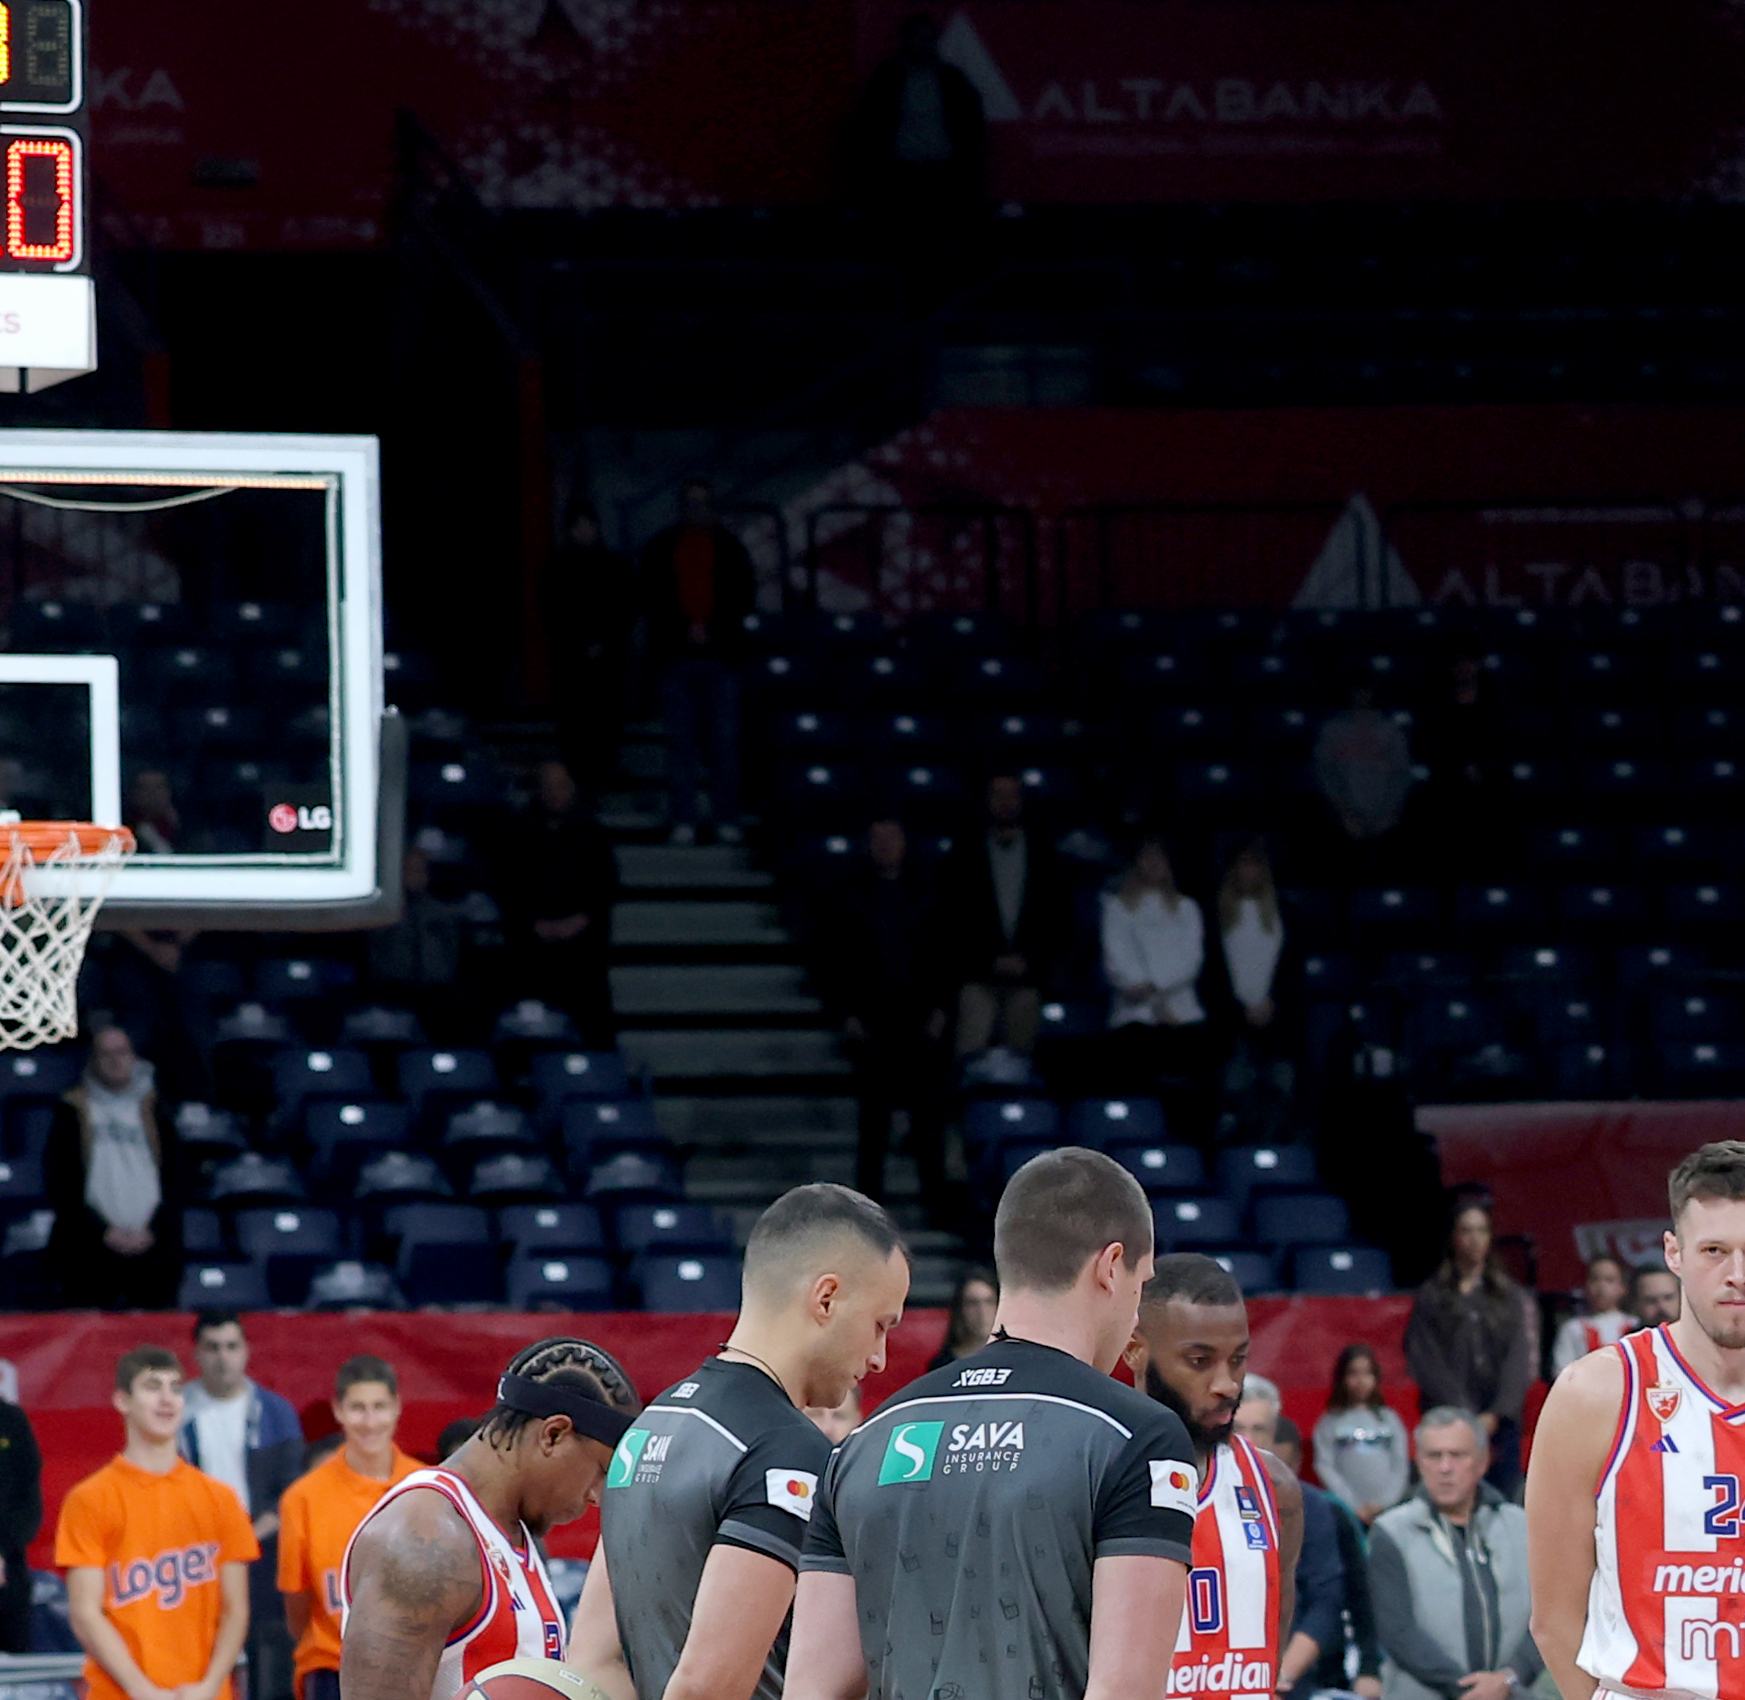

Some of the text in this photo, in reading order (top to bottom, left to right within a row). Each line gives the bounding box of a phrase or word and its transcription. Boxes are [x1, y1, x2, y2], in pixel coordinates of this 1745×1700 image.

[1033, 77, 1444, 122] ALTABANKA
[297, 806, 331, 830] LG
[948, 1421, 1024, 1451] SAVA
[943, 1462, 1018, 1475] GROUP
[944, 1451, 1021, 1464] INSURANCE
